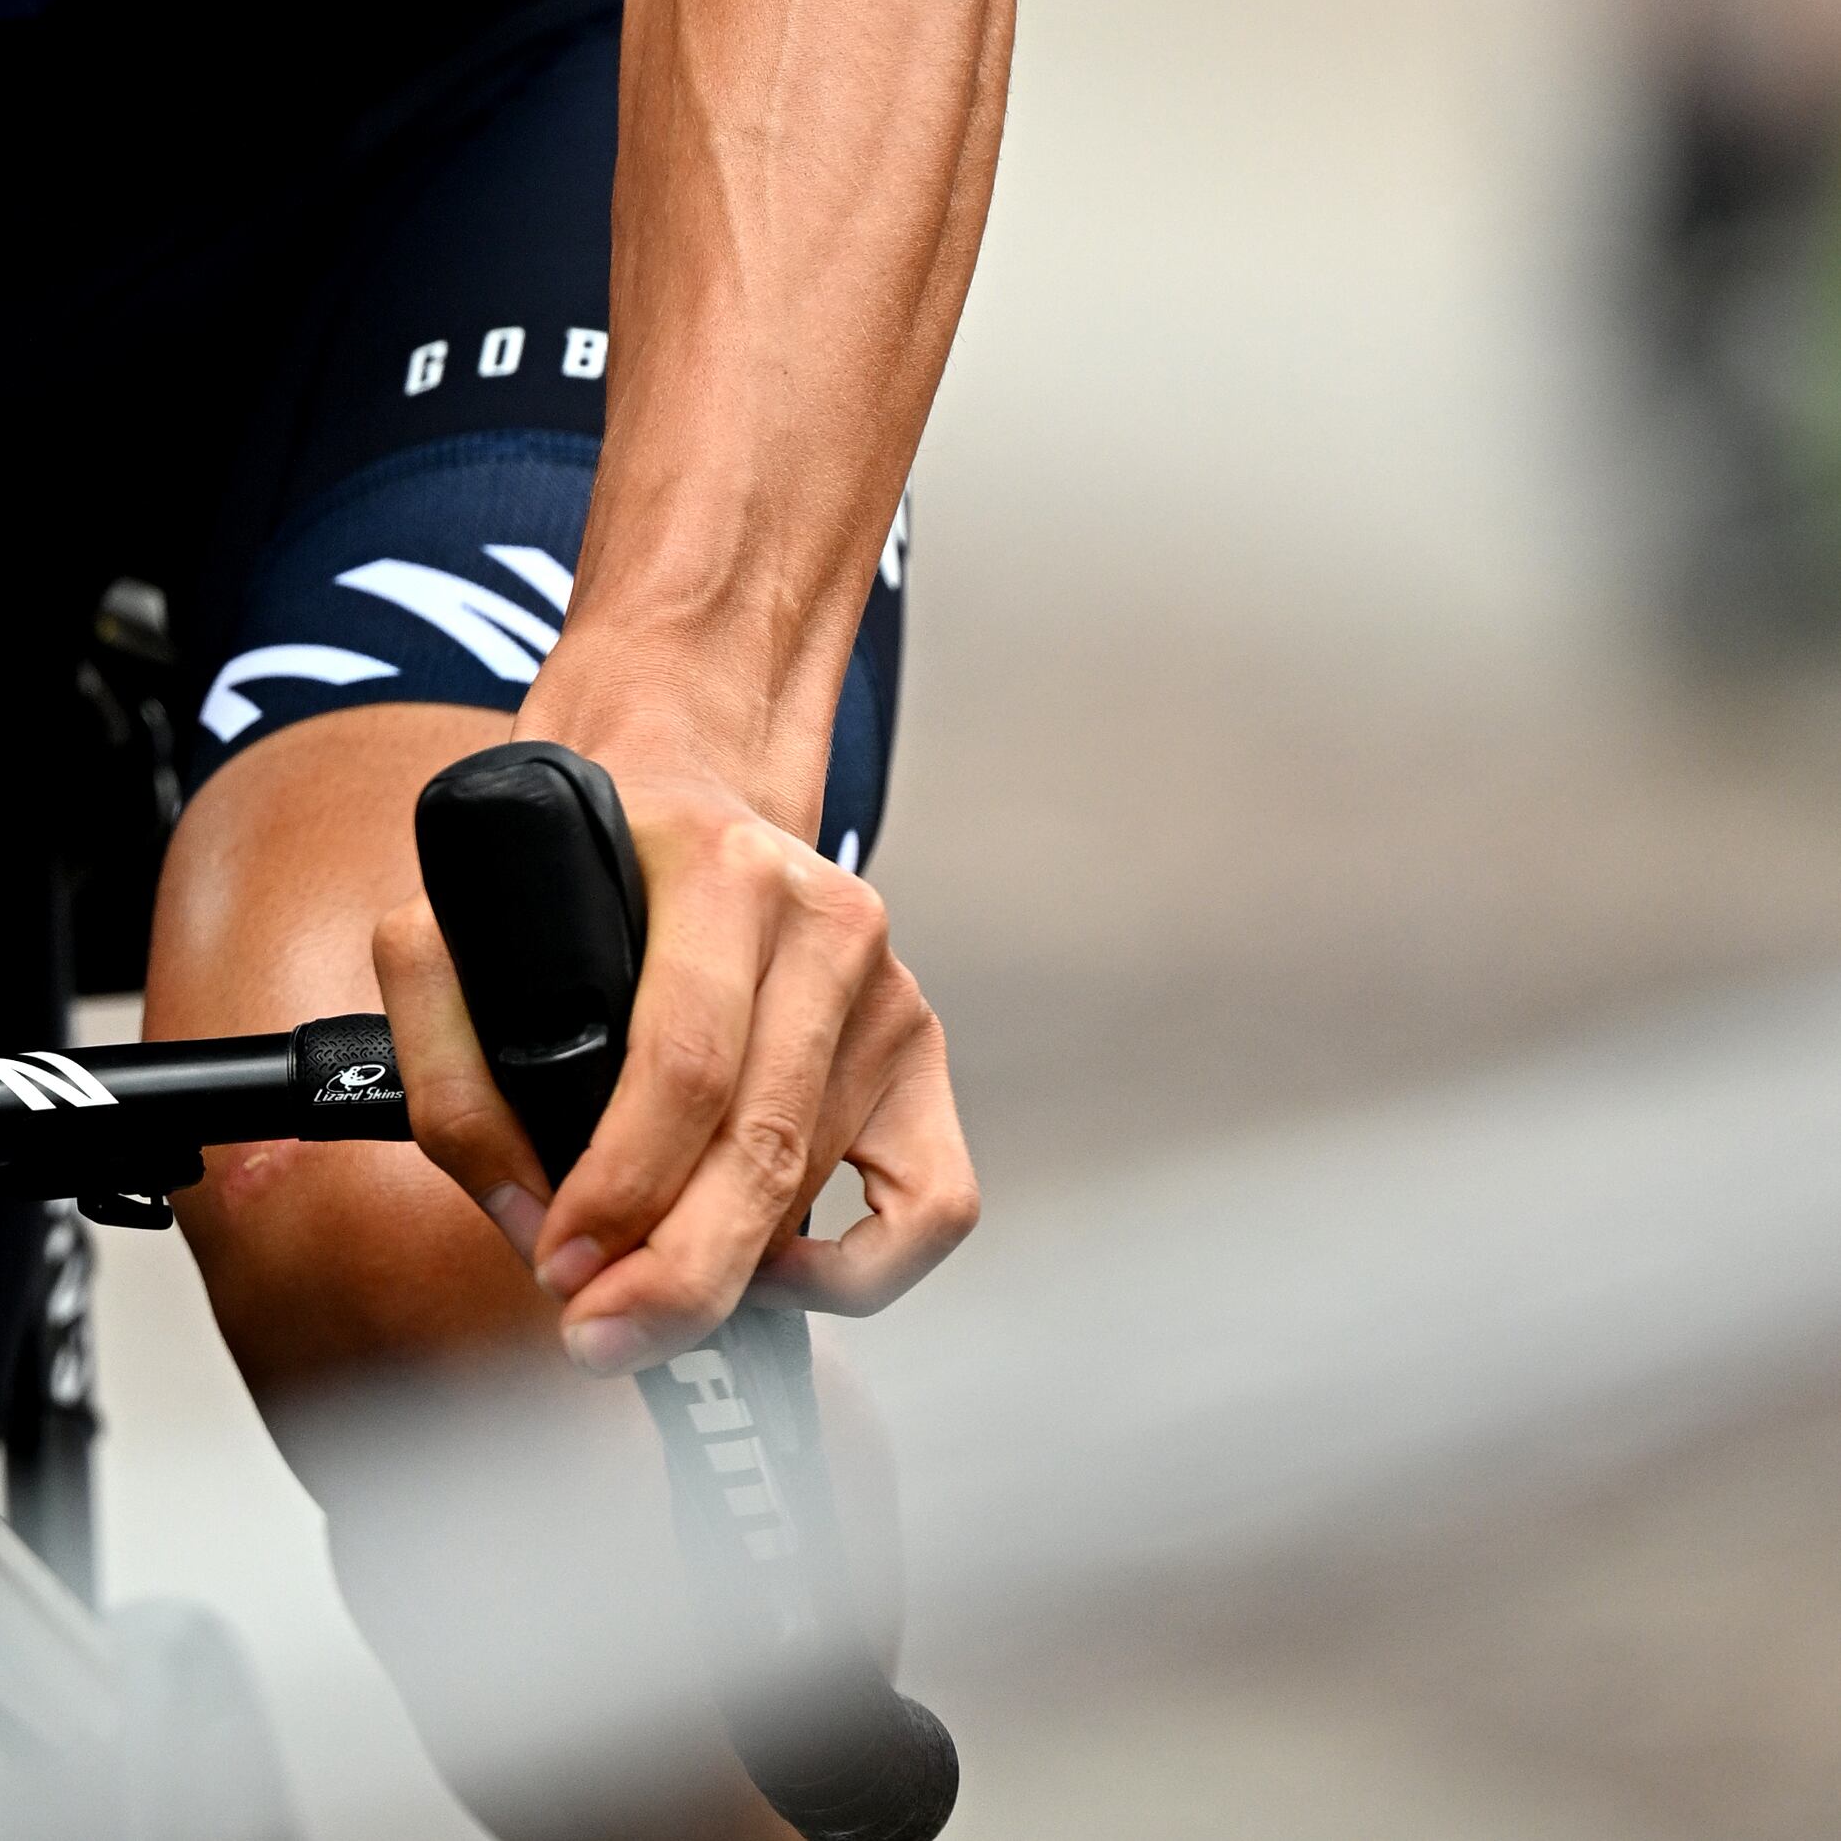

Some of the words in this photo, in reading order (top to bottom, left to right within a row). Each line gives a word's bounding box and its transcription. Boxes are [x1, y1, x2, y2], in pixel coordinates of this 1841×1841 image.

[404, 325, 609, 397] GOB
[313, 1088, 364, 1103] Lizard
[363, 1086, 405, 1101] Skins
